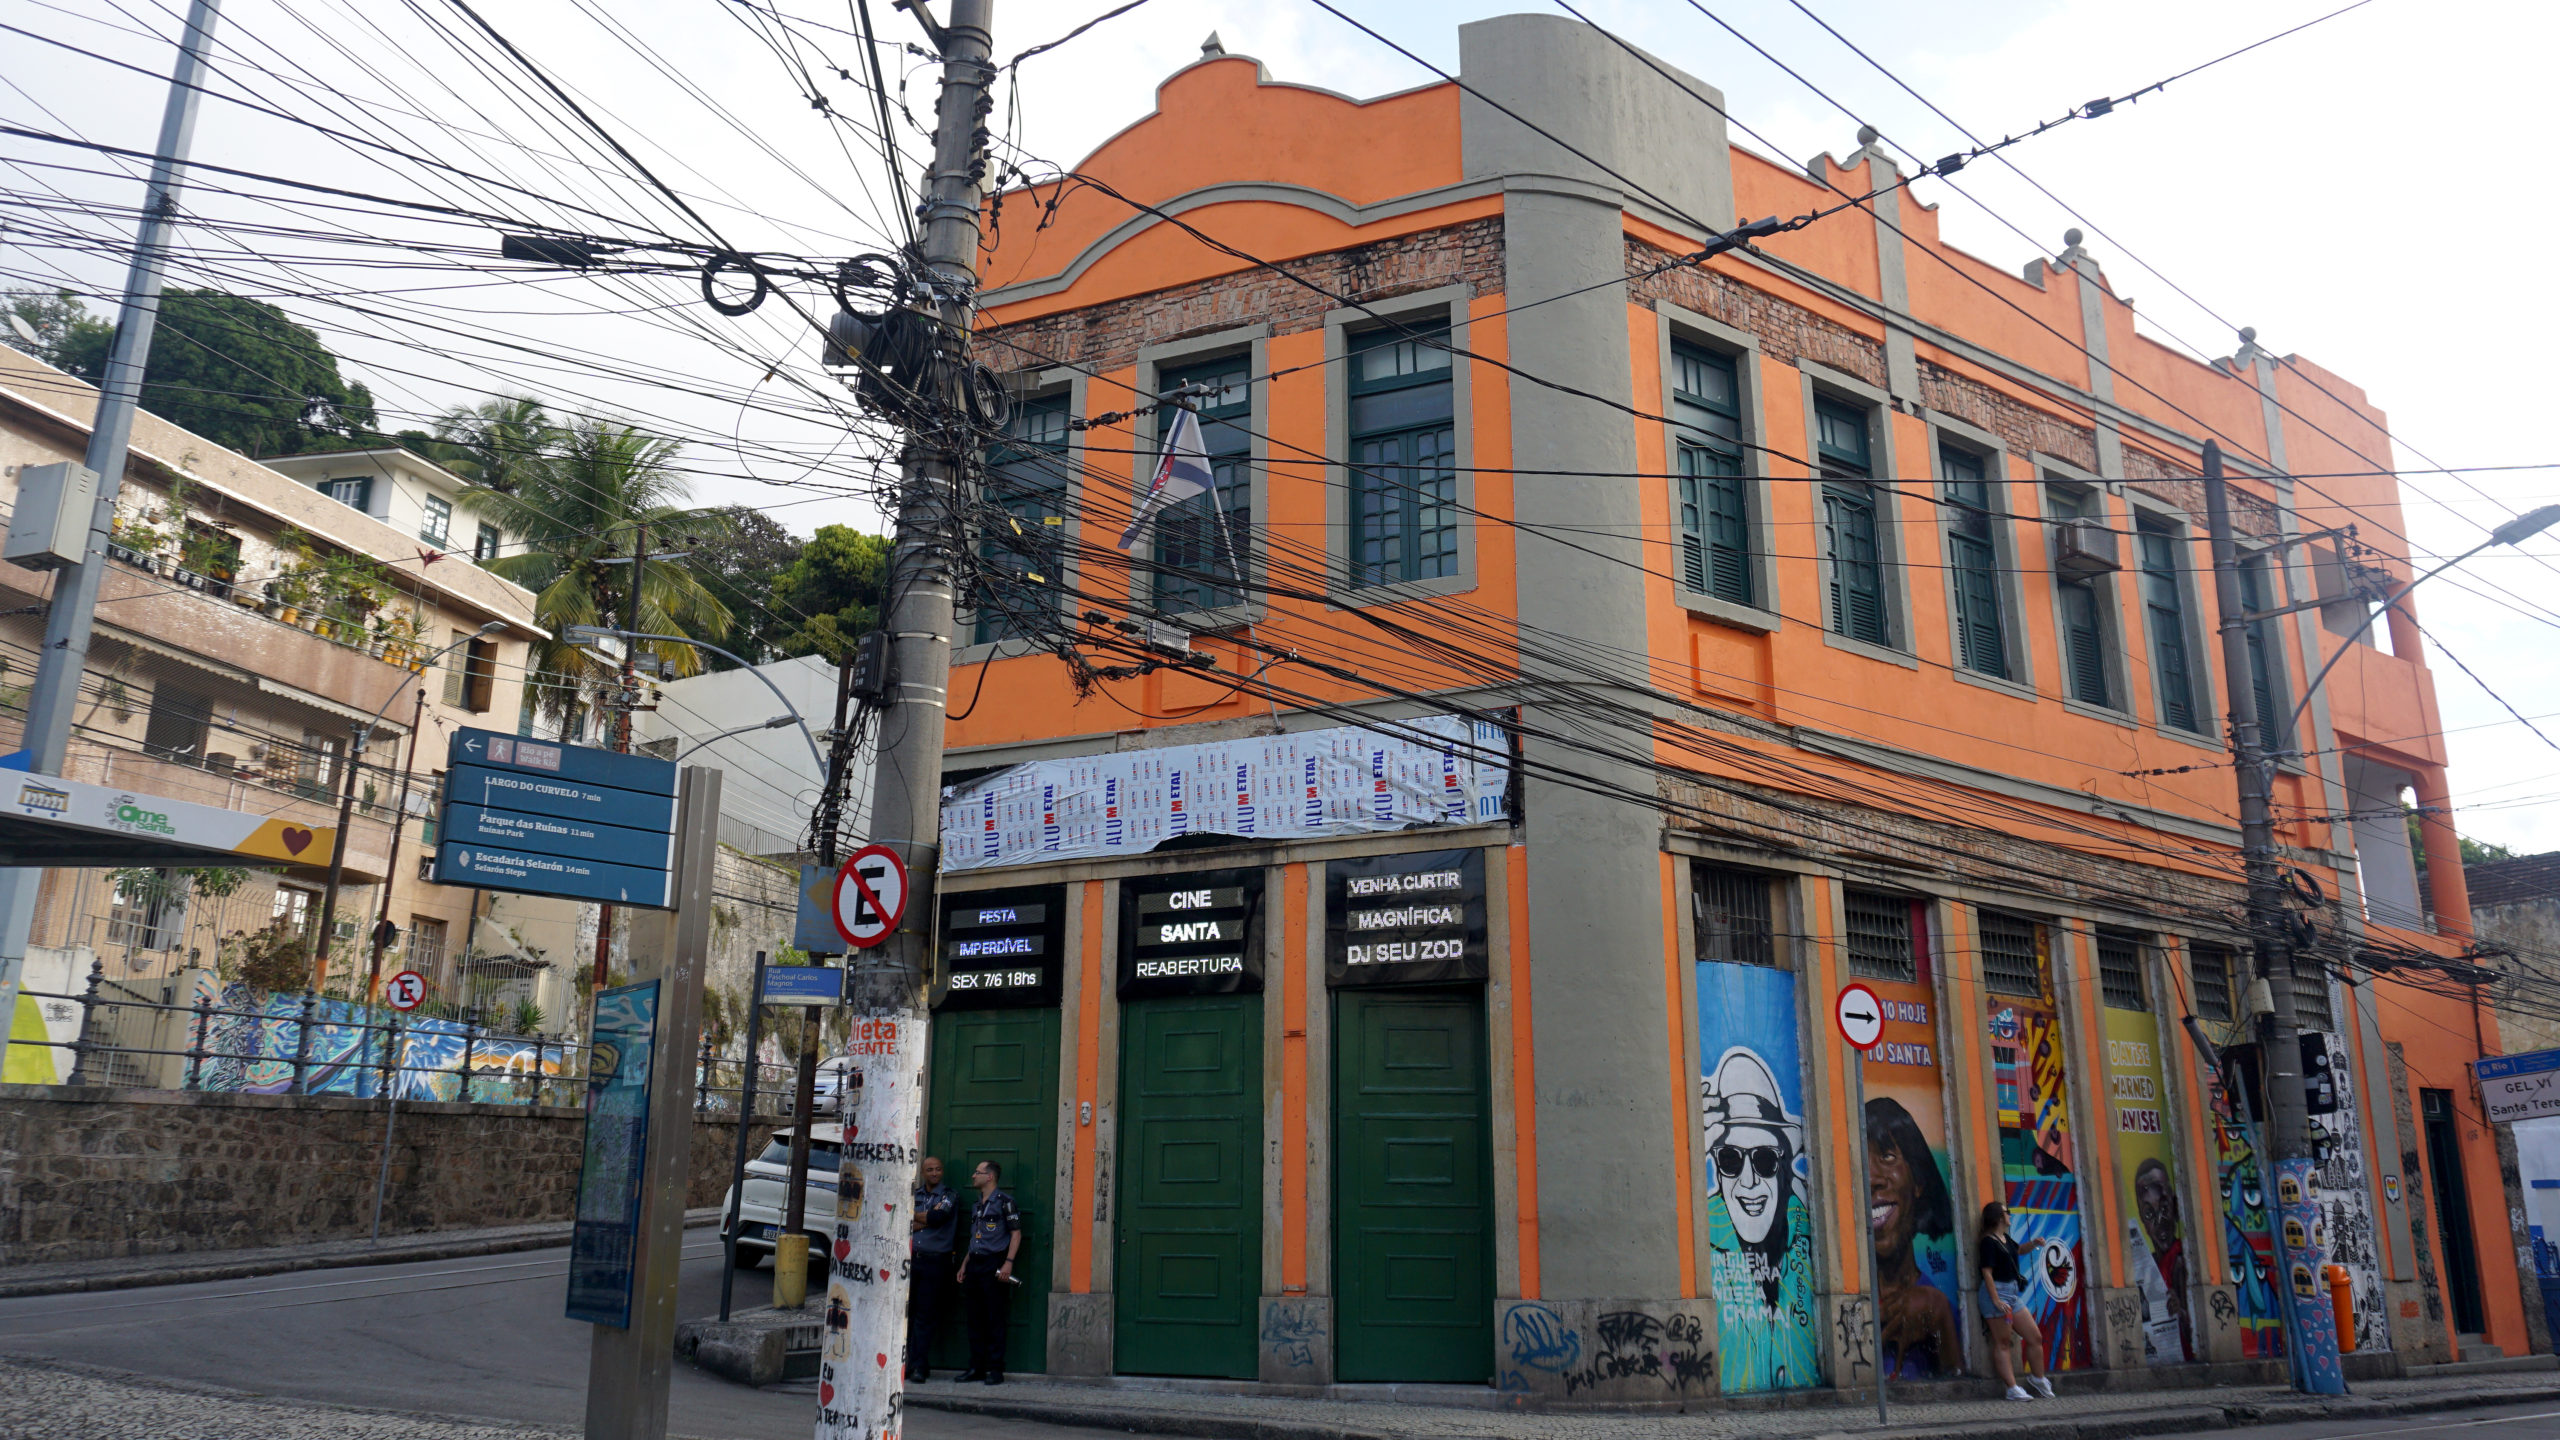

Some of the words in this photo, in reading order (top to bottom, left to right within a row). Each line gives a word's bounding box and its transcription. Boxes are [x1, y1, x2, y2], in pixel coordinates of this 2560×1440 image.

[520, 745, 534, 755] Rio
[543, 750, 554, 758] pé
[520, 755, 541, 765] Walk
[543, 758, 557, 767] Rio
[484, 776, 518, 789] LARGO
[519, 782, 534, 791] DO
[535, 784, 579, 798] CURVELO
[587, 793, 602, 802] min
[1305, 755, 1322, 827] ALUMETAL
[1373, 749, 1393, 821] ALUMETAL
[1237, 763, 1255, 833] ALUMETAL
[1044, 783, 1061, 851] ALUMETAL
[1106, 777, 1122, 846] ALUMETAL
[478, 825, 505, 835] Ruínas
[506, 829, 524, 838] Park
[480, 813, 514, 827] Parque
[516, 819, 533, 829] das
[535, 821, 568, 834] Ruínas
[570, 828, 579, 836] 11
[580, 830, 595, 838] min
[984, 791, 999, 858] ALUMETAL
[474, 863, 505, 874] Selarón
[505, 867, 527, 877] Steps
[476, 852, 525, 867] Escadaria
[526, 858, 563, 872] Selarón
[565, 865, 575, 873] 14
[575, 867, 590, 875] min
[1350, 877, 1401, 894] VENHA
[1403, 872, 1459, 890] CURTIR
[854, 866, 885, 926] E
[1169, 890, 1212, 909] CINE
[979, 909, 1016, 924] FESTA
[1358, 906, 1453, 929] MAGNÍFICA
[1160, 921, 1220, 942] SANTA
[960, 937, 1032, 956] IMPERDÍVEL
[1347, 945, 1370, 964] DJ
[1376, 942, 1416, 962] SEU
[1421, 939, 1463, 960] ZOD
[767, 973, 796, 981] Paschoal
[1136, 957, 1242, 977] REABERTURA
[952, 974, 979, 989] SEX
[983, 973, 1003, 987] 7/6
[1007, 971, 1036, 986] 18hs
[1898, 1001, 1928, 1024] HOJE
[1887, 1042, 1933, 1067] SANTA
[2505, 1081, 2534, 1094] GEL
[844, 1112, 856, 1127] EU
[2491, 1102, 2528, 1116] Santa
